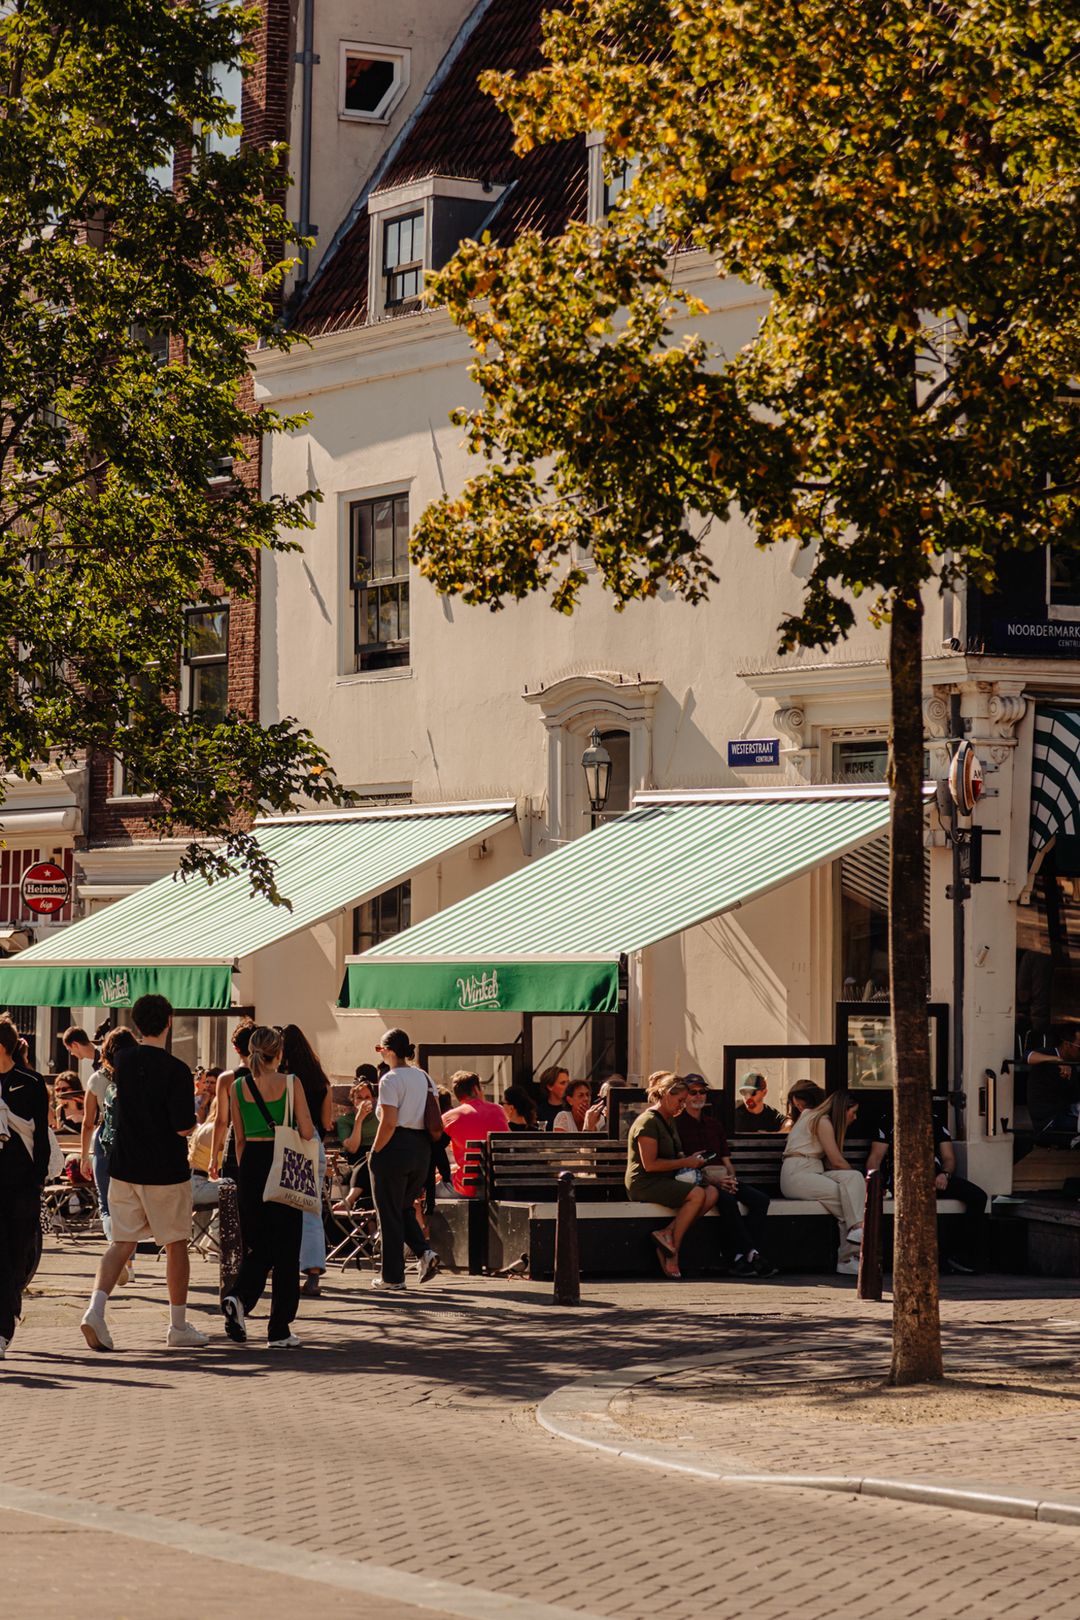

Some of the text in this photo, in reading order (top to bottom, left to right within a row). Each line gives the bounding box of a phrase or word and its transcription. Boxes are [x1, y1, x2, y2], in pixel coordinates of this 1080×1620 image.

[732, 742, 774, 755] WESTERSTRAAT
[756, 751, 774, 763] CENTRUM
[27, 884, 66, 893] Heineken
[98, 971, 129, 1001] Winkel
[457, 969, 499, 1006] Winkel
